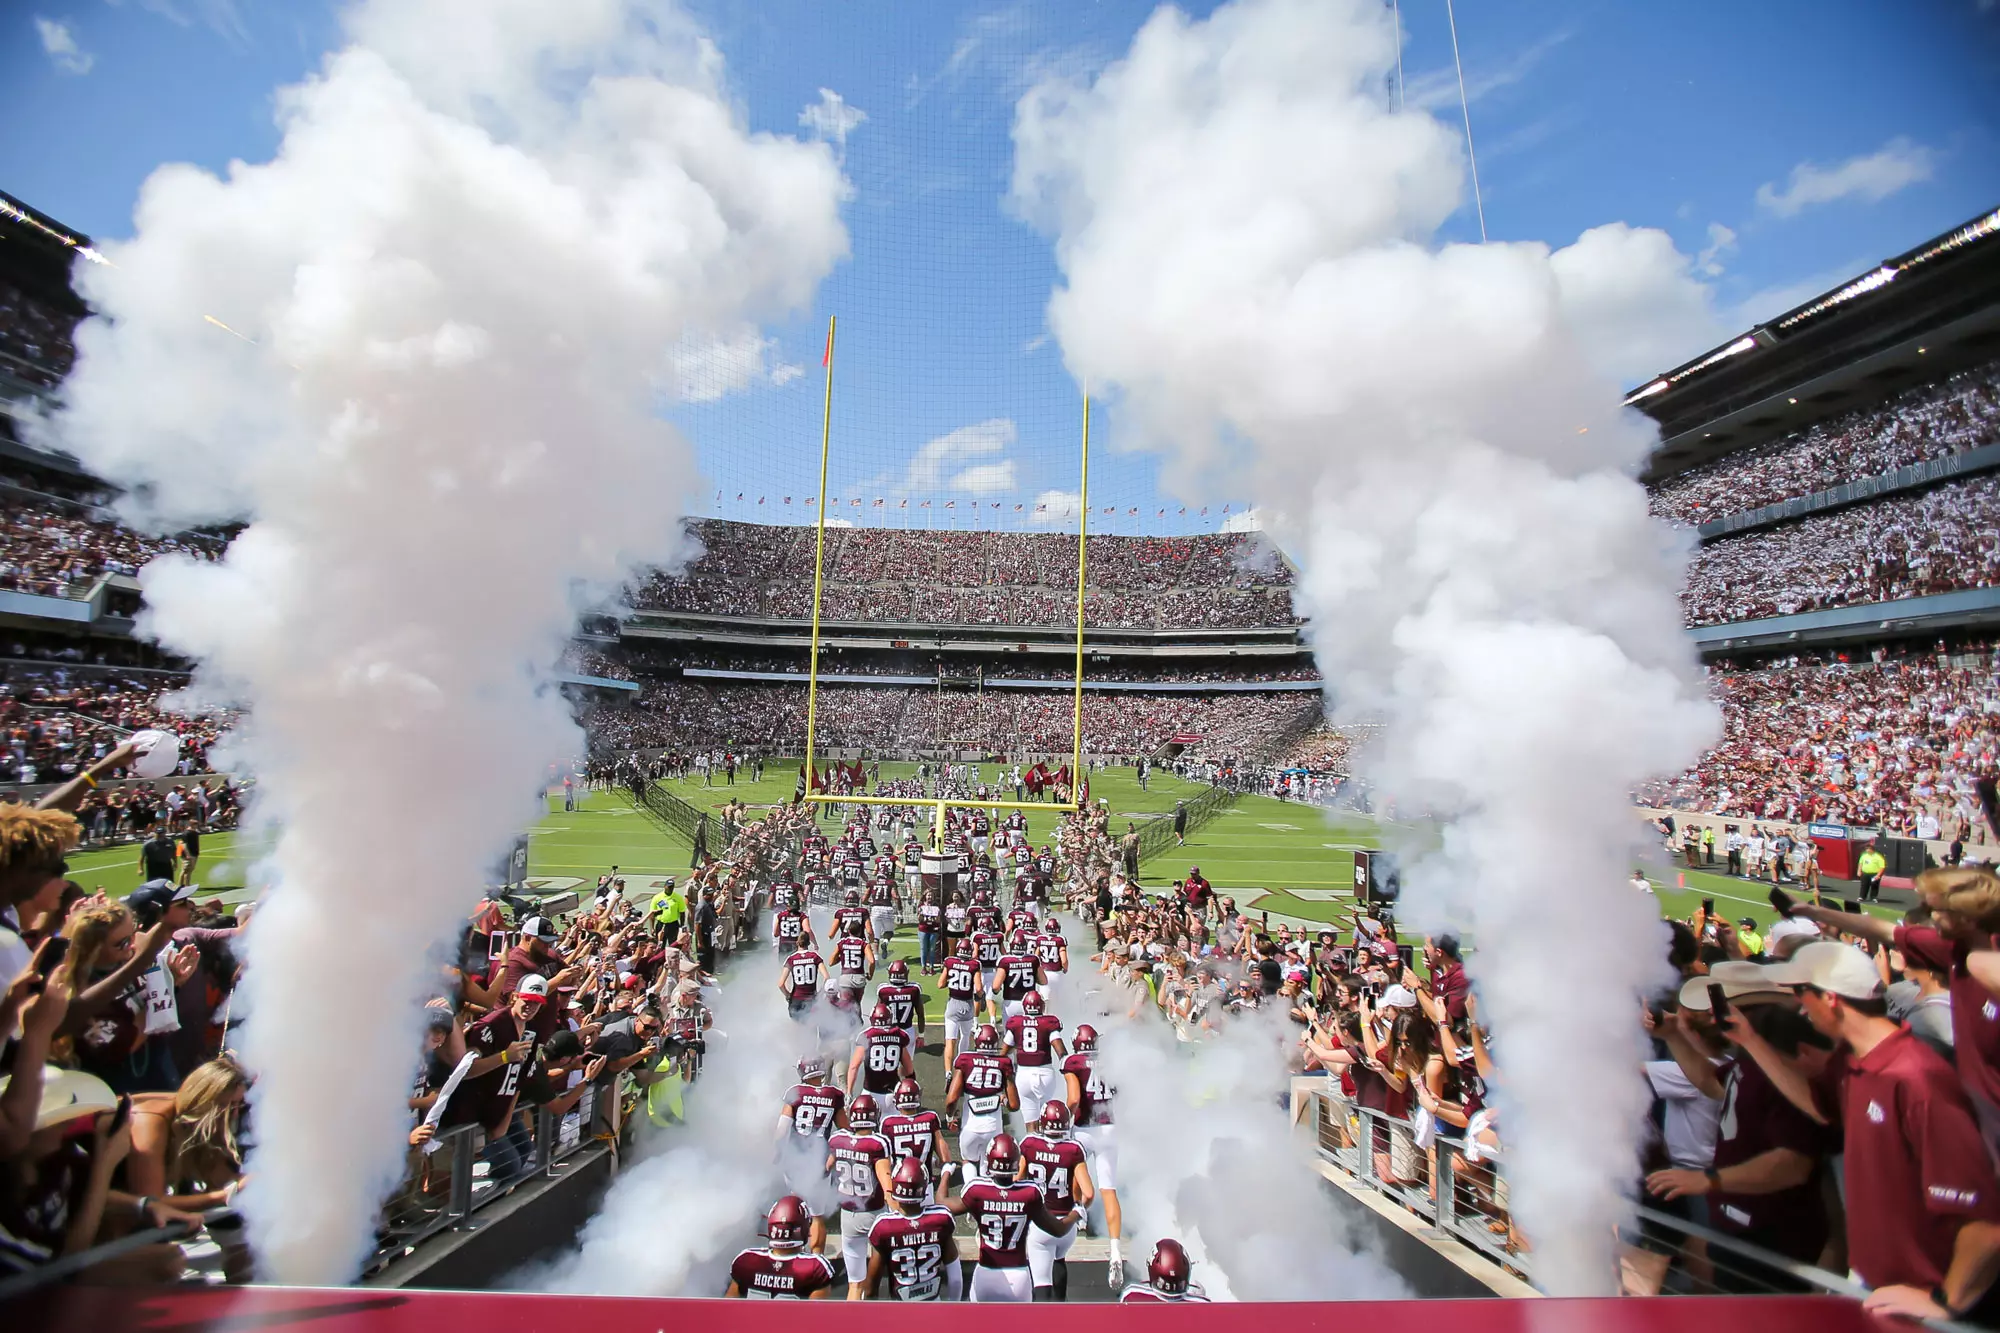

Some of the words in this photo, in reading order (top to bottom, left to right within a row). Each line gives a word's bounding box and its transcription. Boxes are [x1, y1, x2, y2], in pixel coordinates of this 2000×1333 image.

[1724, 508, 1766, 532] HOME
[1774, 500, 1793, 519] OF
[1804, 488, 1839, 511] THE
[1847, 471, 1899, 500] 12TH
[1909, 456, 1961, 484] MAN
[873, 885, 888, 900] 71
[1024, 883, 1033, 896] 4
[780, 921, 801, 937] 93
[842, 949, 862, 968] 15
[979, 944, 1000, 960] 30
[1039, 946, 1059, 963] 34
[793, 965, 816, 984] 80
[948, 970, 972, 991] 20
[1008, 969, 1034, 988] 75
[890, 1002, 913, 1024] 17
[1022, 1027, 1039, 1053] 8
[869, 1044, 900, 1071] 89
[972, 1058, 1000, 1067] WILSON
[497, 1063, 522, 1096] 12
[965, 1067, 1003, 1089] 40
[802, 1095, 833, 1106] SCOGGIN
[795, 1104, 835, 1138] 87
[893, 1122, 931, 1134] RUTLEDGE
[893, 1132, 933, 1161] 57
[1035, 1151, 1061, 1163] MANN
[835, 1160, 874, 1197] 29
[1028, 1162, 1069, 1199] 34
[983, 1200, 1025, 1213] BROBBEY
[777, 1229, 790, 1239] 73
[902, 1232, 927, 1246] WHITE
[981, 1214, 1028, 1250] 37
[891, 1243, 942, 1285] 32
[753, 1273, 795, 1289] HOCKER
